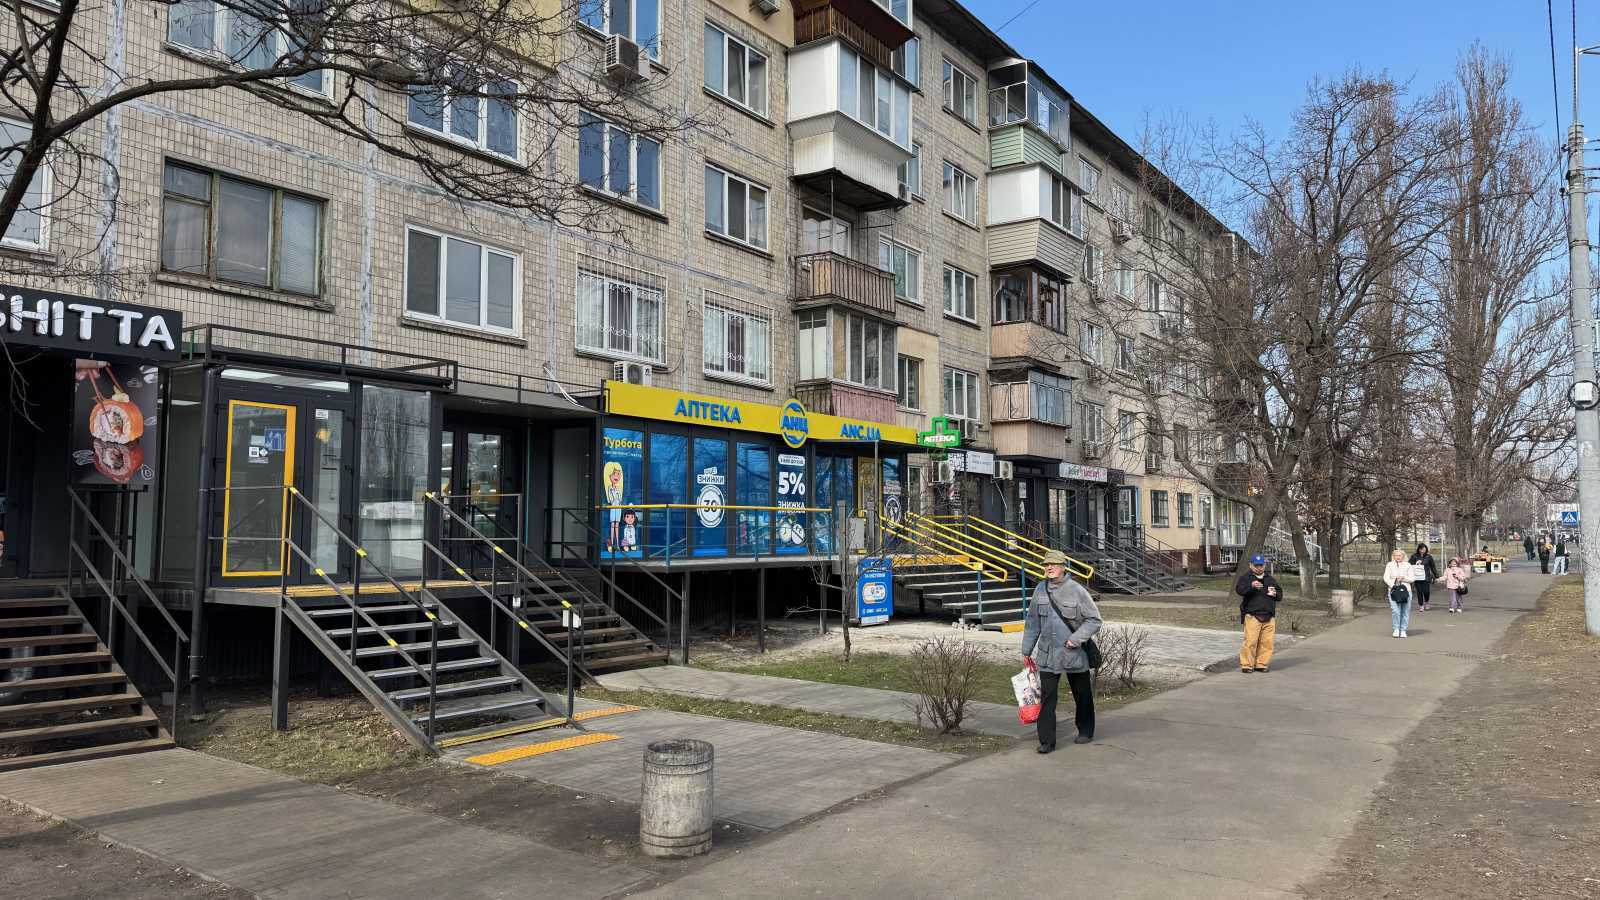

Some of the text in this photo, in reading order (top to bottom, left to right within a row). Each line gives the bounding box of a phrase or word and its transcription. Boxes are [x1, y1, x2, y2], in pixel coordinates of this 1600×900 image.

[0, 292, 175, 351] HITTA
[675, 399, 742, 423] АПТЕКА
[781, 415, 809, 433] АНЦ
[840, 424, 881, 440] ANC.UA
[603, 437, 642, 449] Турбота
[923, 435, 956, 443] АПТЕКА
[698, 475, 724, 484] ЗНИЖКИ
[778, 472, 806, 495] 5%
